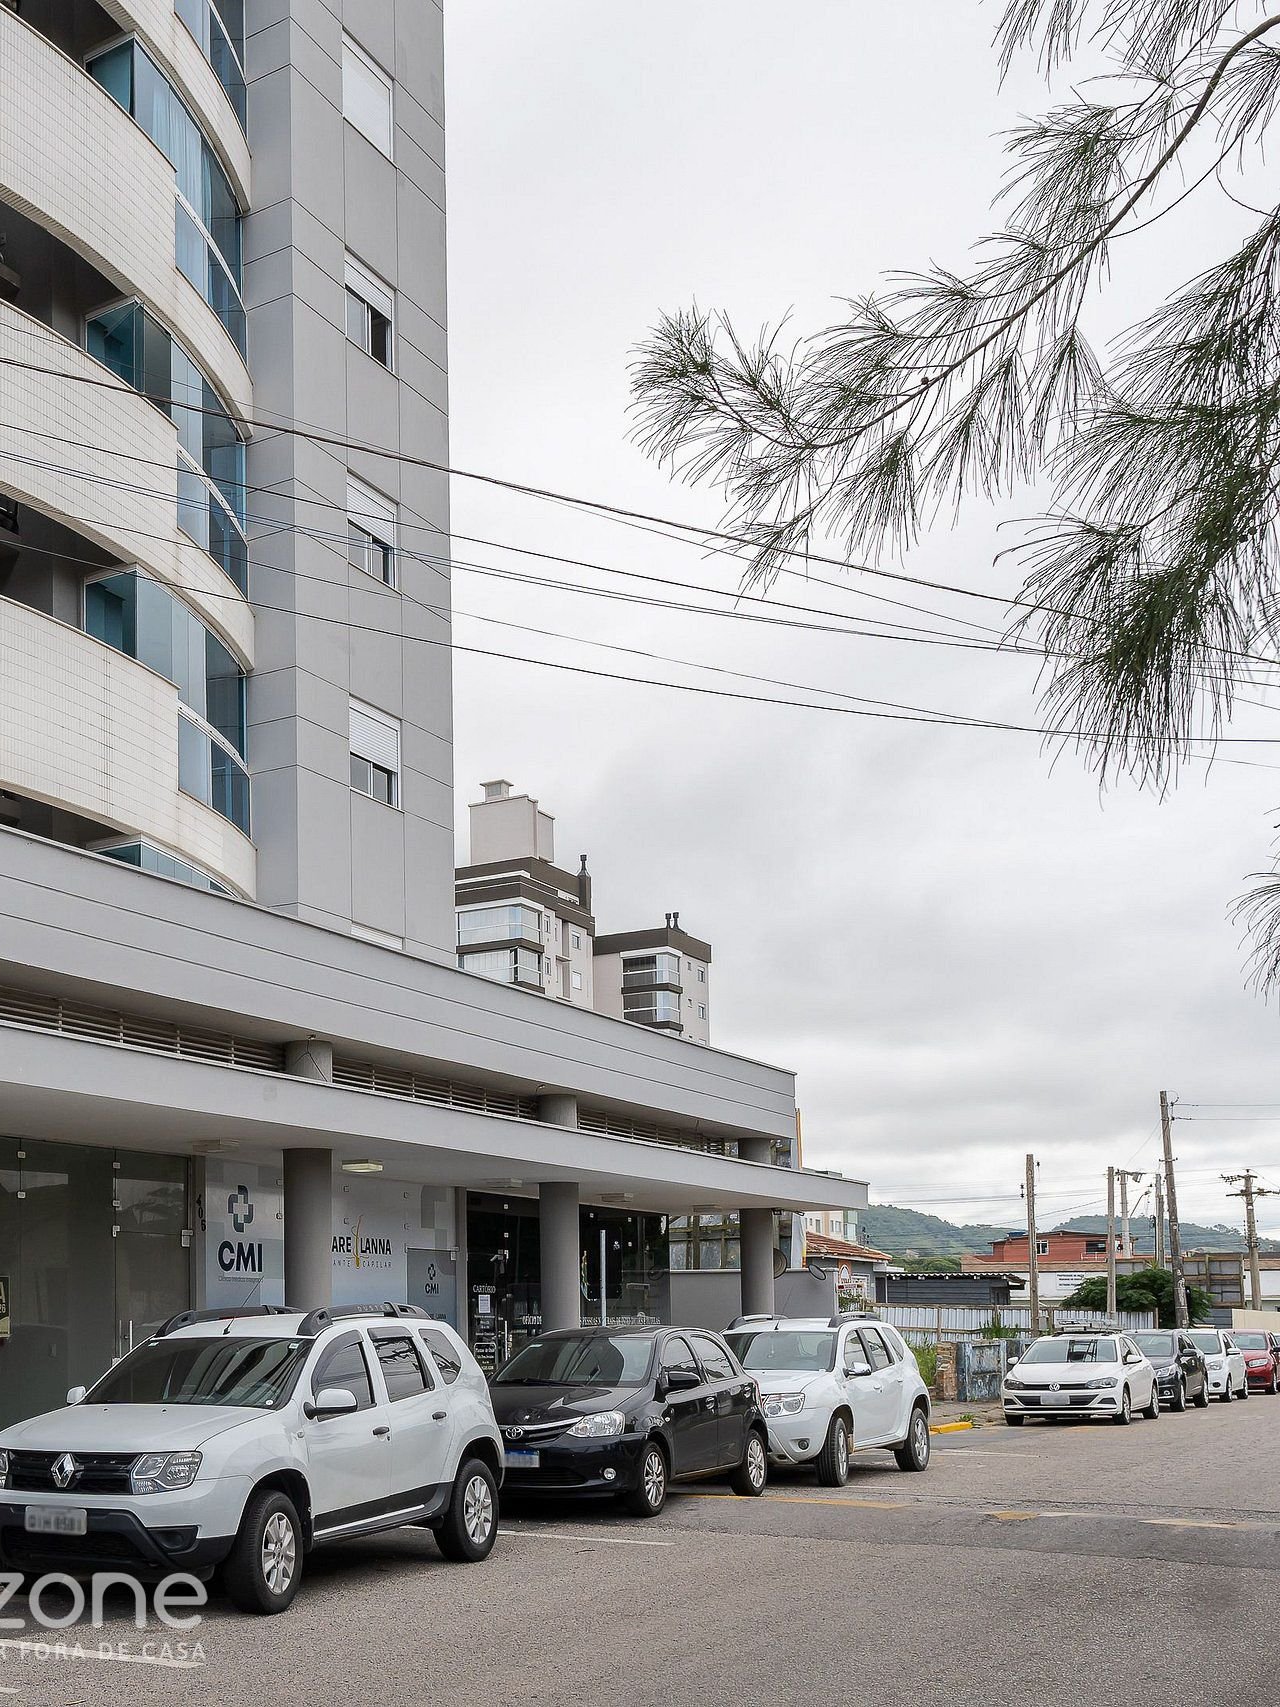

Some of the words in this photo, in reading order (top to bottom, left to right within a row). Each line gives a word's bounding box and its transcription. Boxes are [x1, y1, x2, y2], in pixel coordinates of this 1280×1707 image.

[360, 1237, 392, 1255] LANNA
[218, 1240, 263, 1272] CMI
[424, 1283, 439, 1294] CMI
